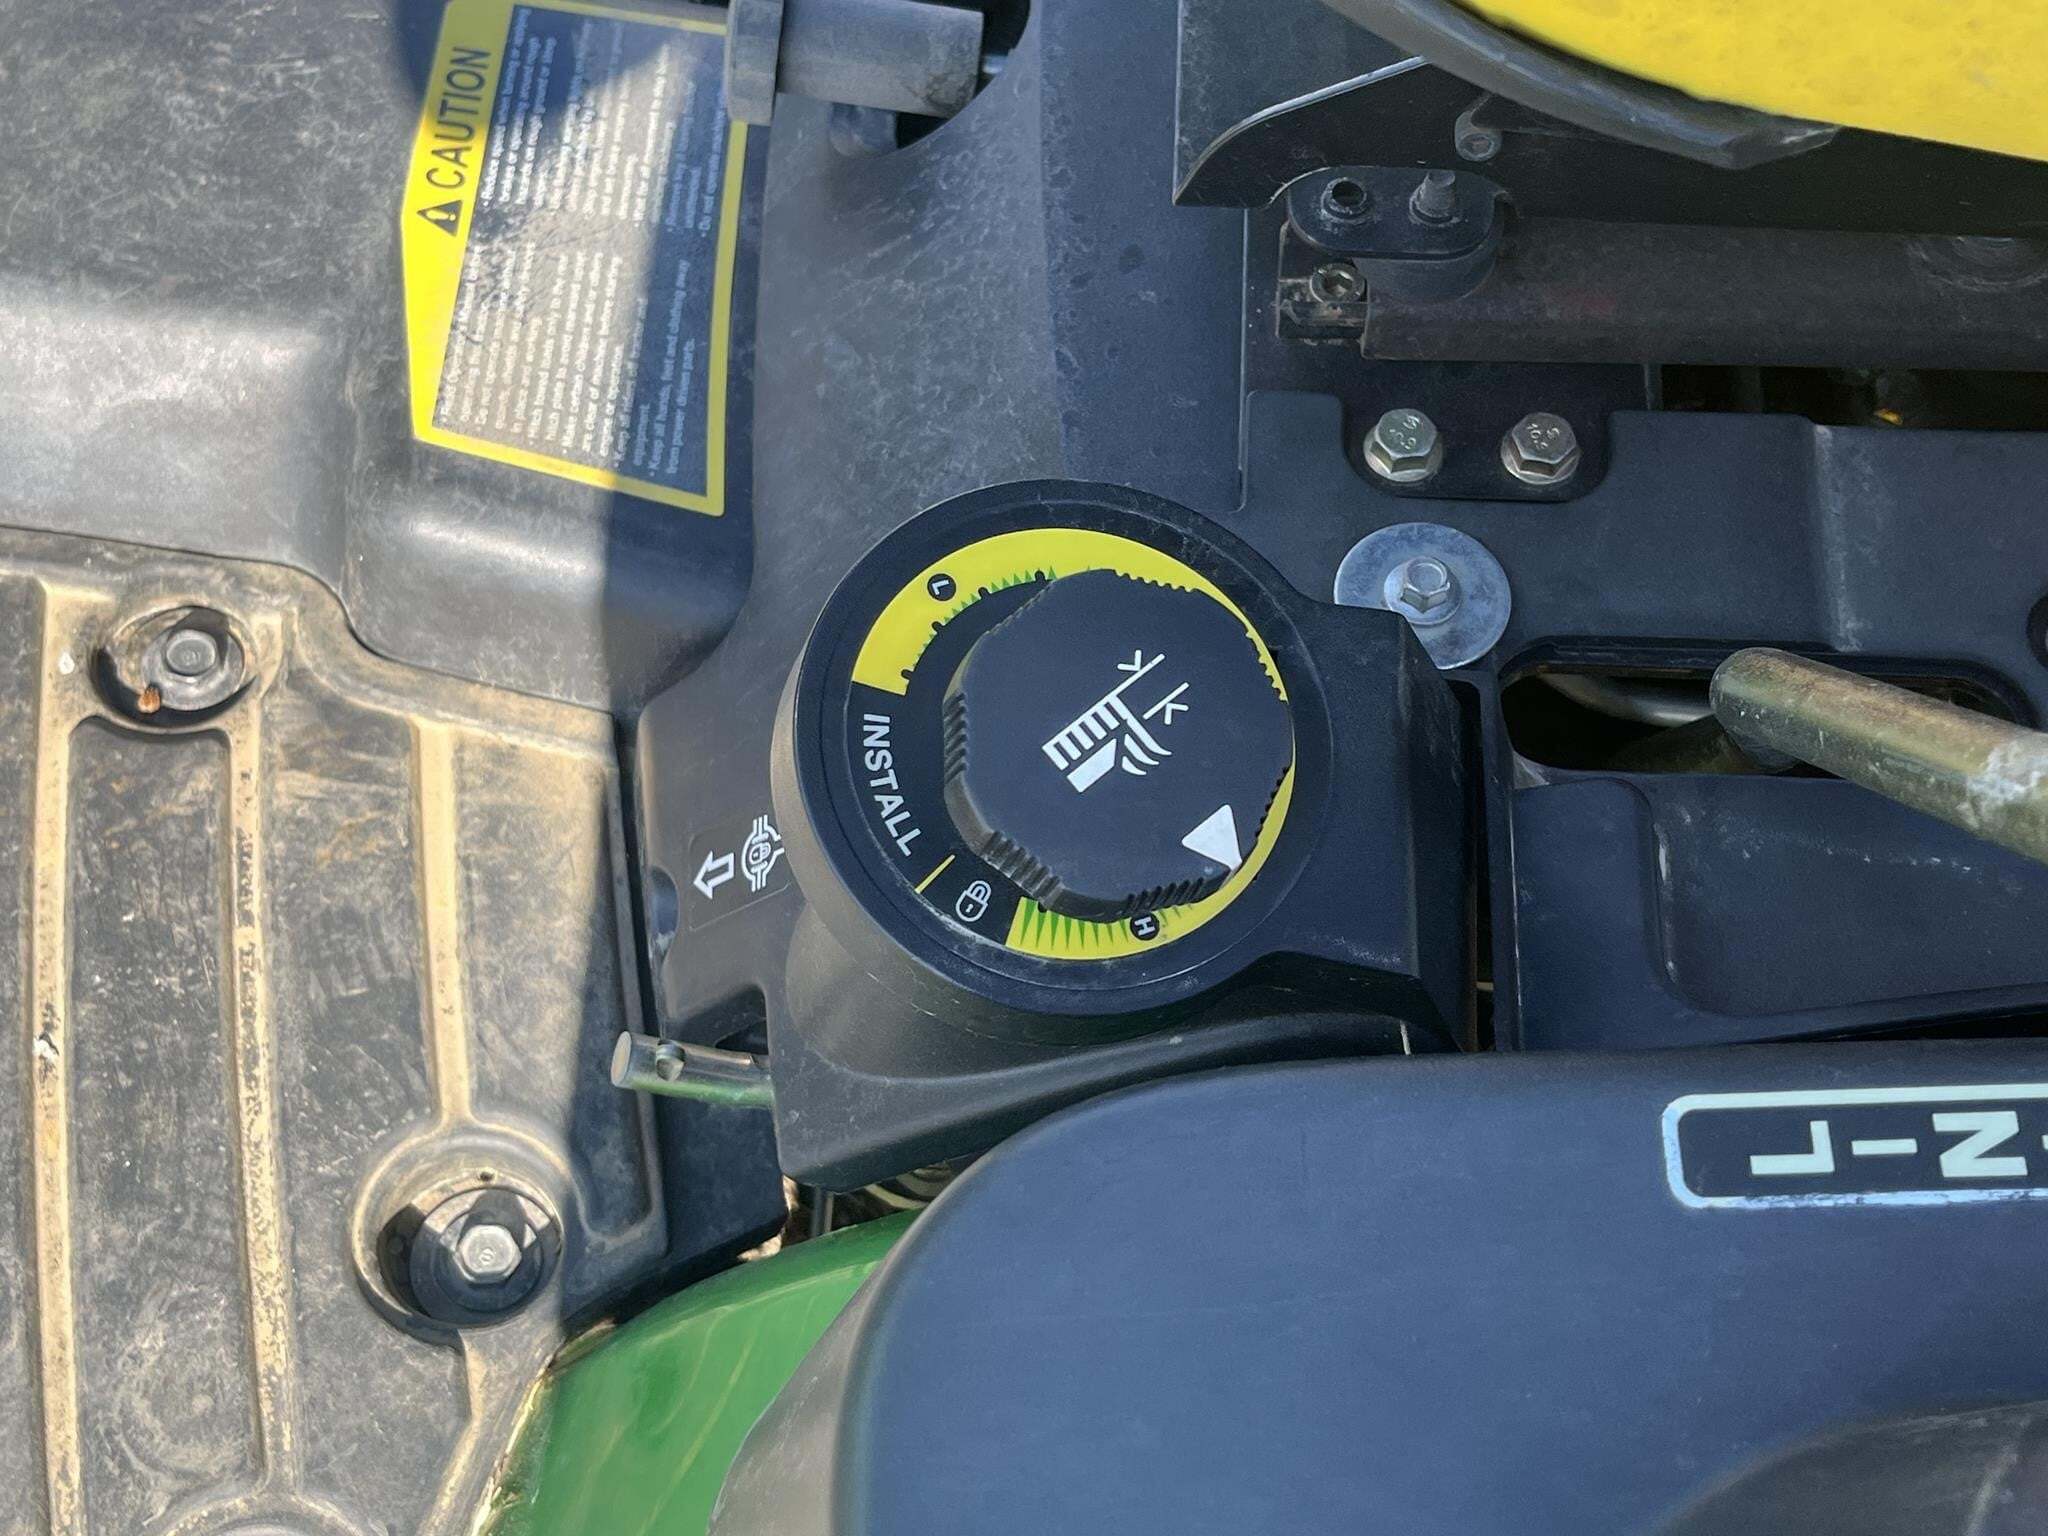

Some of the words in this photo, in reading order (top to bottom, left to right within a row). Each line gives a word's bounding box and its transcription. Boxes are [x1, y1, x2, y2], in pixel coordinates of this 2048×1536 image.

[426, 47, 491, 189] CAUTION
[669, 289, 685, 333] clothing
[665, 334, 678, 356] and
[653, 422, 665, 436] all
[649, 438, 663, 470] Keep
[932, 579, 950, 595] L
[863, 713, 922, 857] INSTALL
[1135, 917, 1156, 936] H
